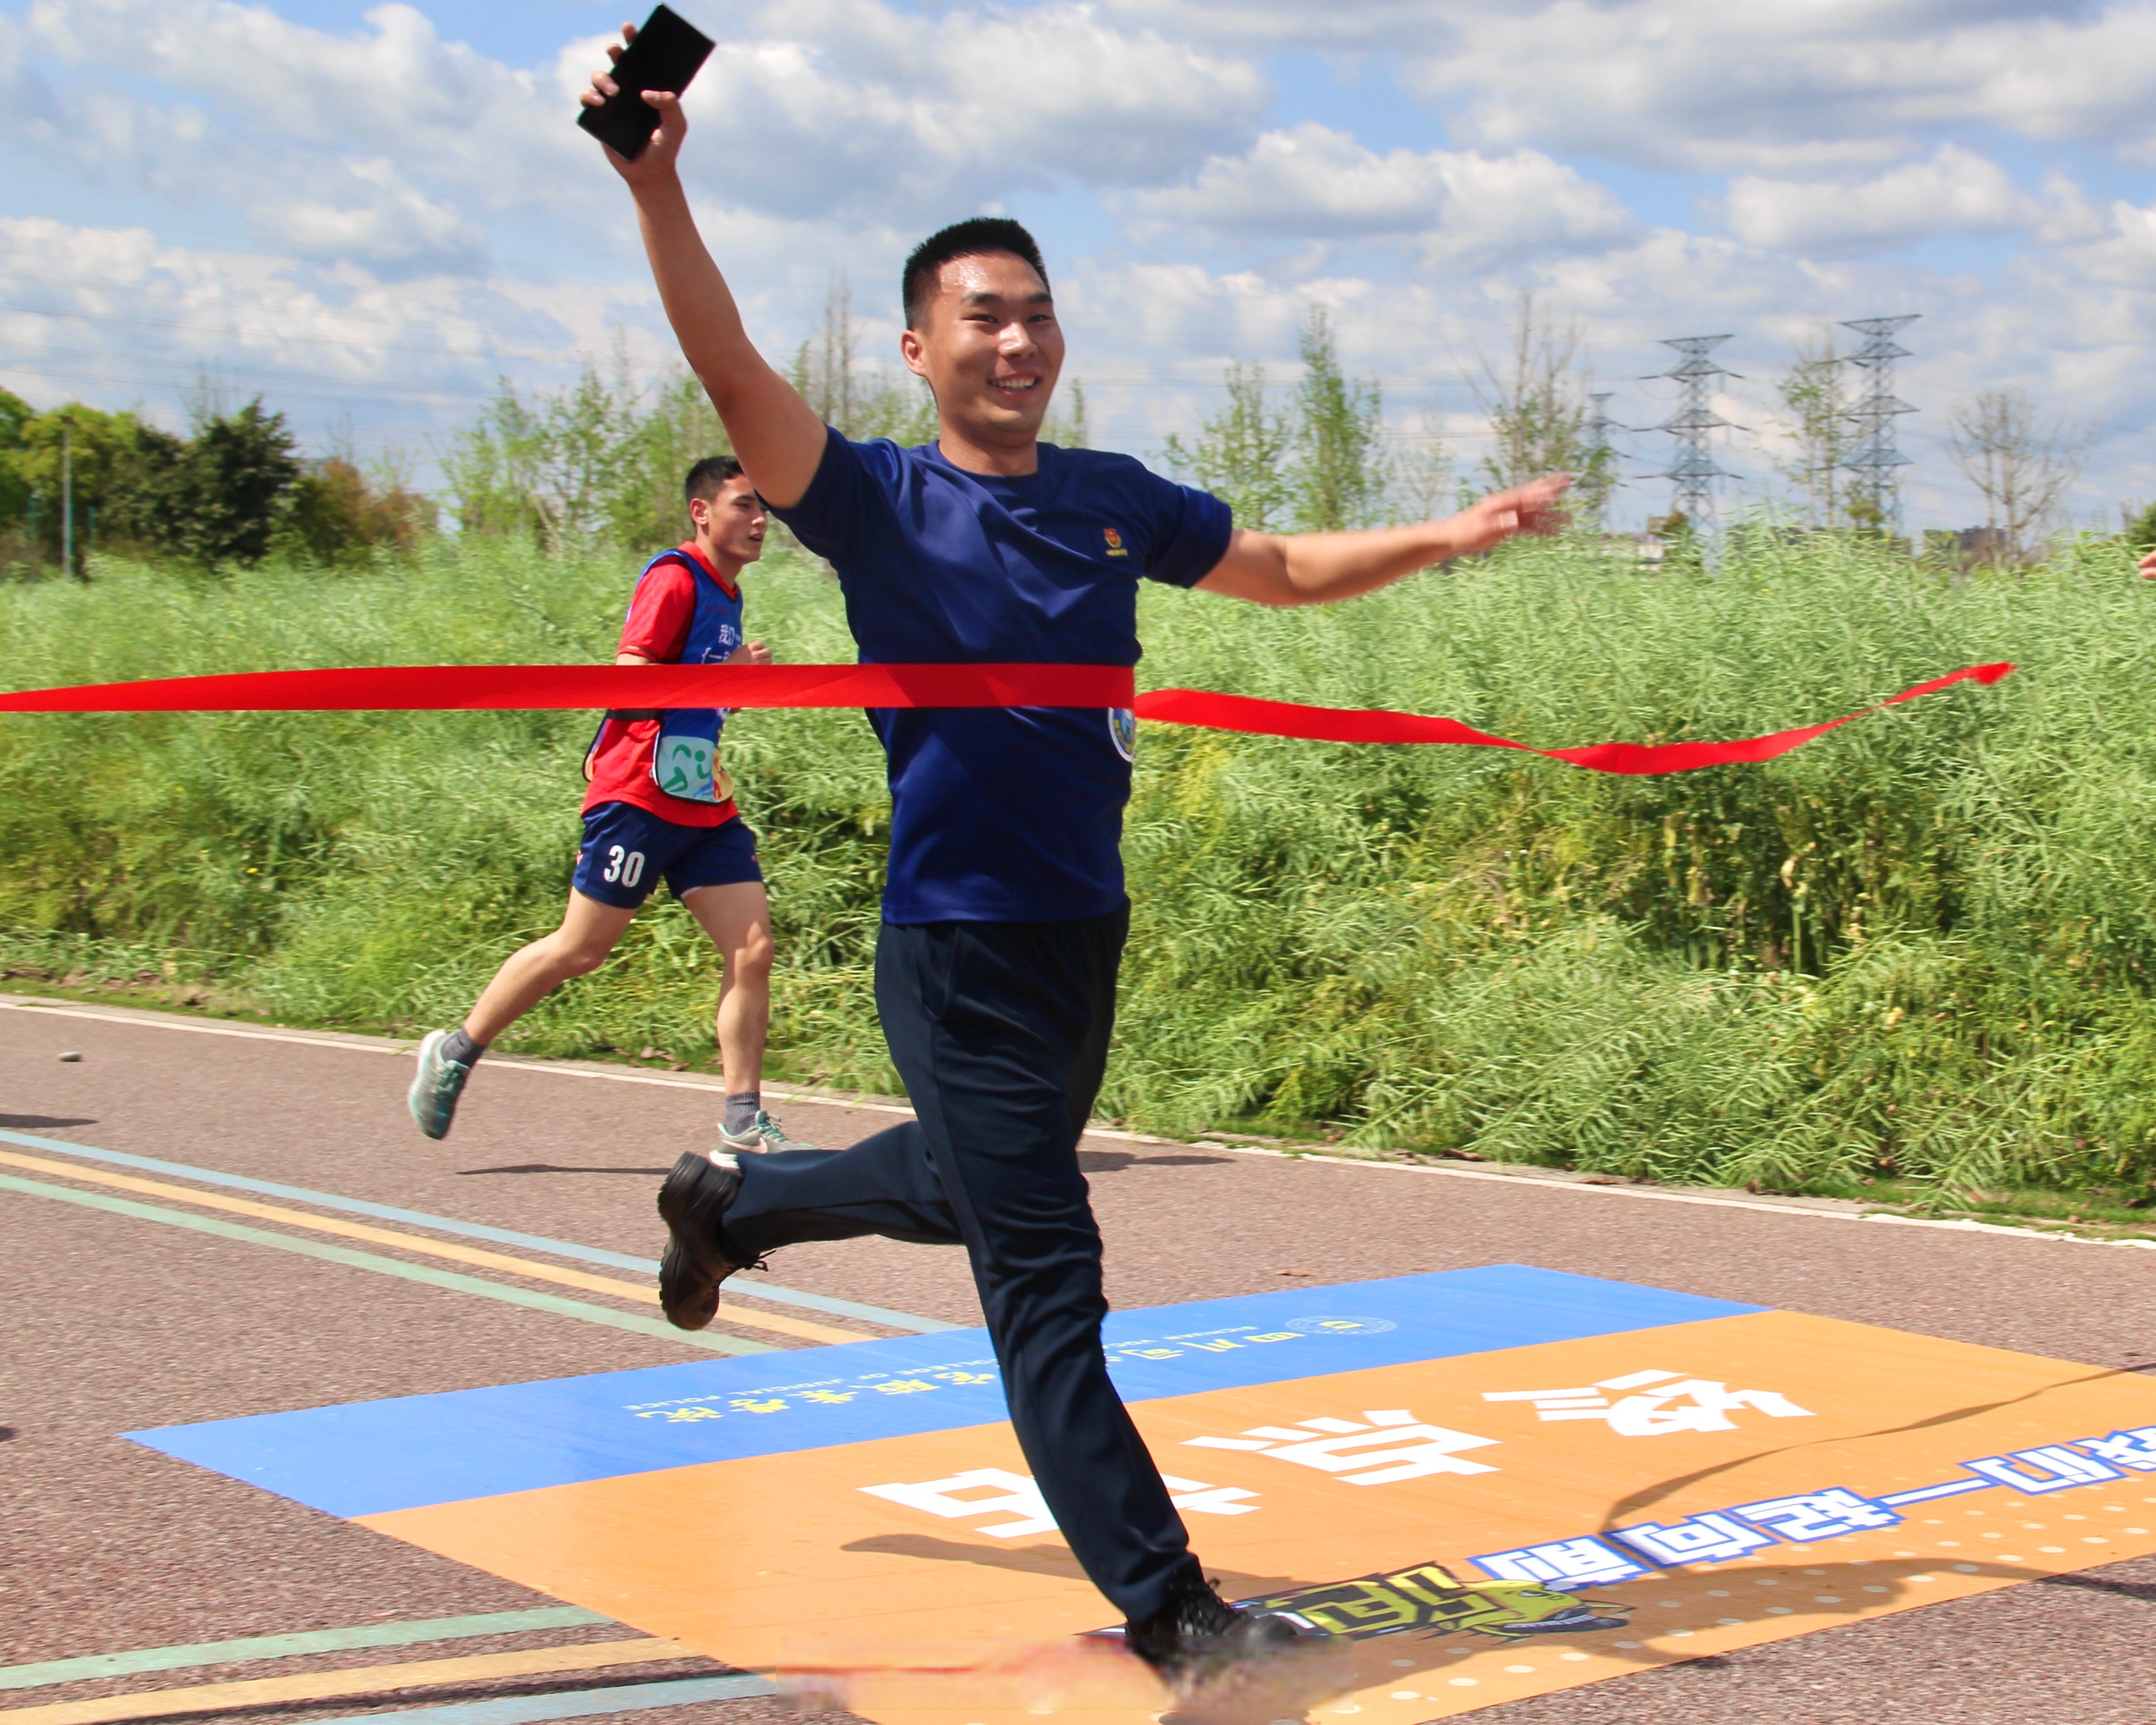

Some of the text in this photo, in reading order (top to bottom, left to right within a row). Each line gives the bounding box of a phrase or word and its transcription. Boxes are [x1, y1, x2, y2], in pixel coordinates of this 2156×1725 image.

[604, 845, 645, 888] 30
[1162, 1325, 1260, 1340] SICHUAN
[857, 1372, 890, 1380] OF
[727, 1378, 844, 1396] JUDICIAL
[621, 1395, 722, 1411] POLICE
